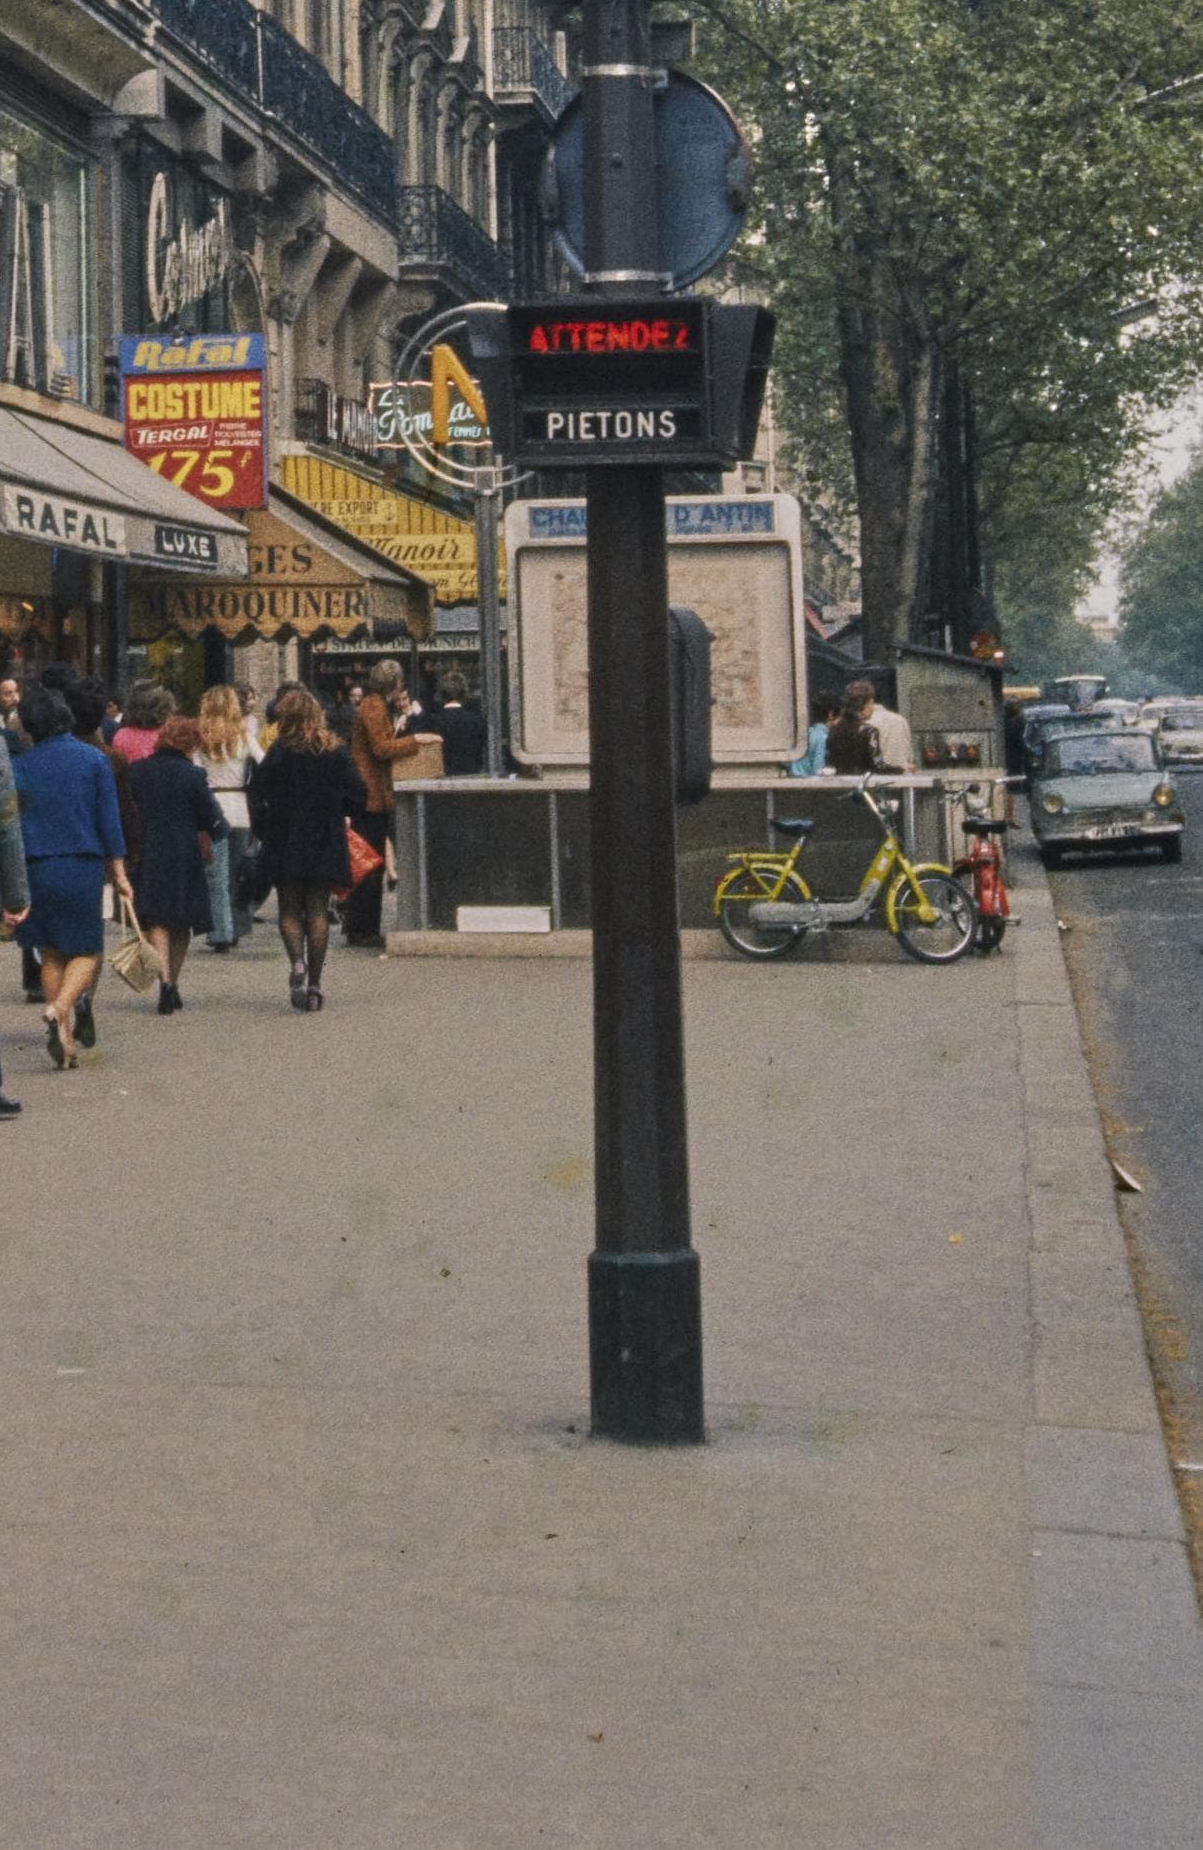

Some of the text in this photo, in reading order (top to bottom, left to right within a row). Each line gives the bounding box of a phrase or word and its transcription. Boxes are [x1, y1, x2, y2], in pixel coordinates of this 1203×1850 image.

[133, 336, 252, 372] Rafal
[530, 319, 690, 354] ATTENDEZ
[128, 380, 262, 421] COSTUME
[137, 425, 210, 446] TERGAL
[547, 410, 677, 440] PIETONS
[15, 494, 212, 558] RAFAL LUXE
